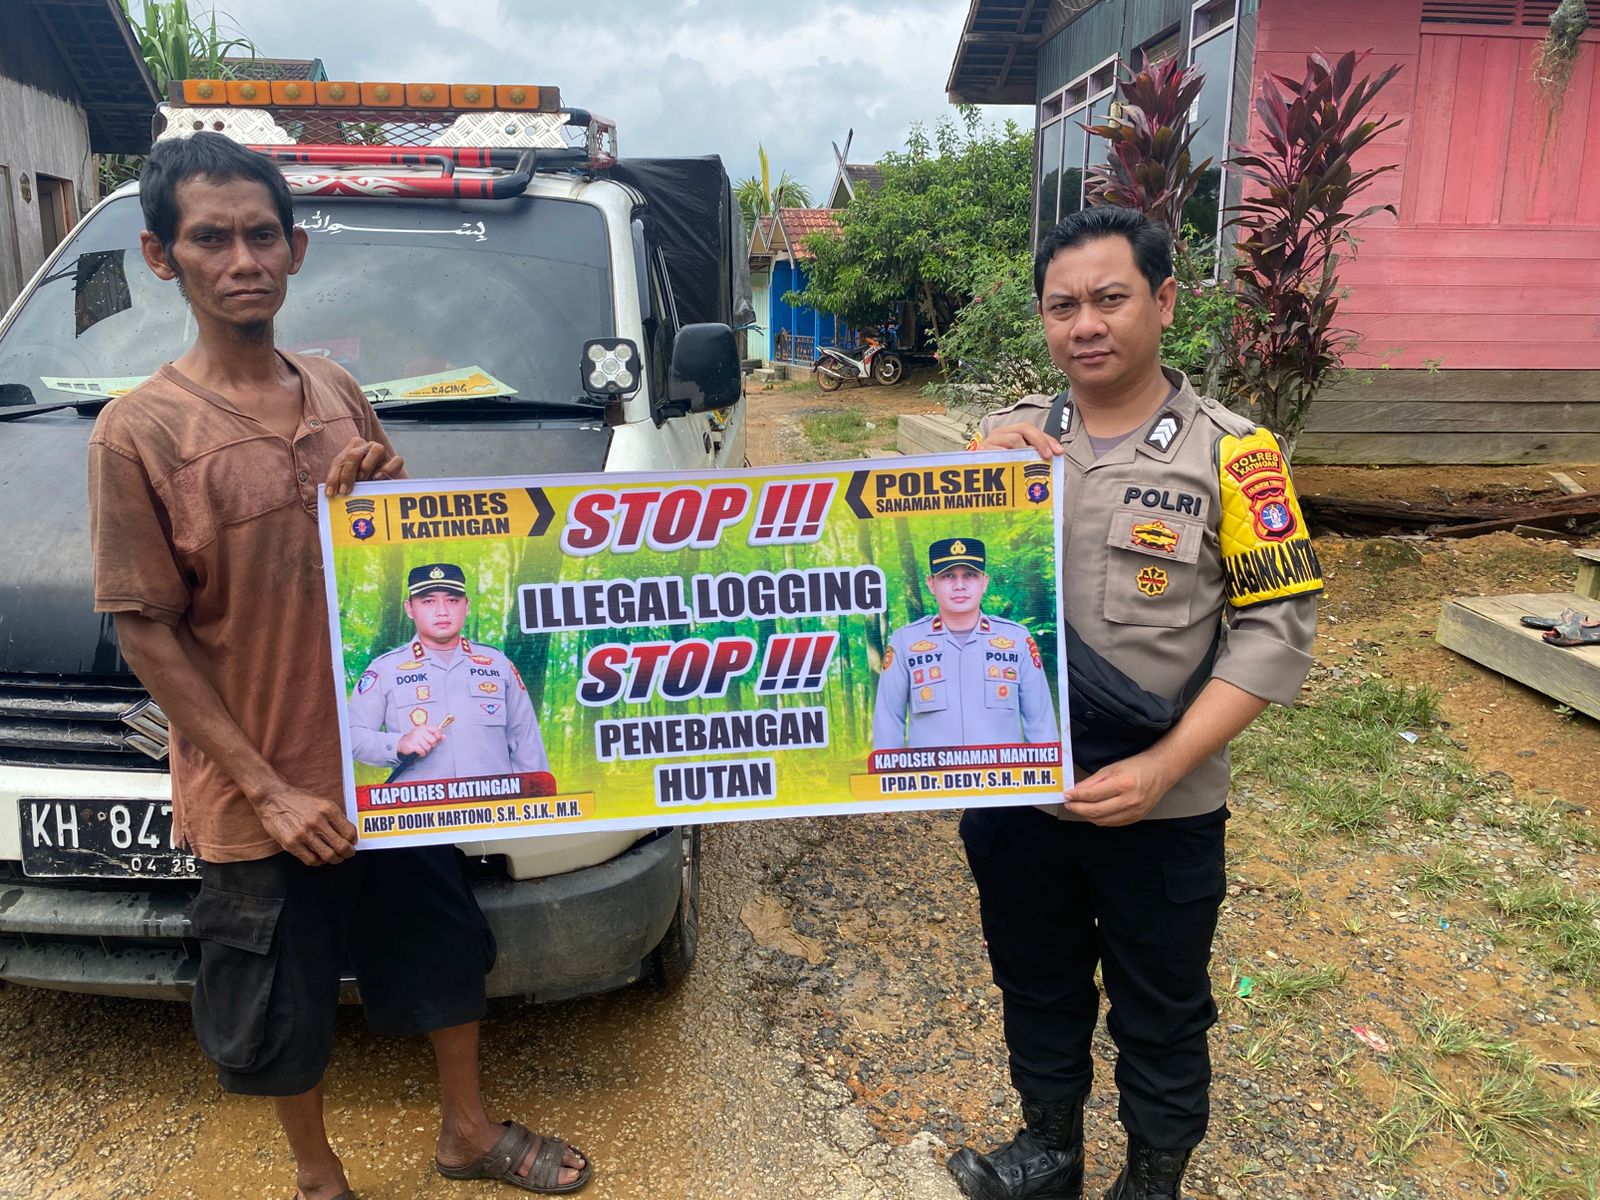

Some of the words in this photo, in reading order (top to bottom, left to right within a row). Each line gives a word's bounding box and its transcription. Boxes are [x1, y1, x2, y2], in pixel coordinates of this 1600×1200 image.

[431, 384, 468, 395] RACING
[1231, 452, 1279, 472] POLRES
[875, 467, 1006, 498] POLSEK
[399, 492, 509, 520] POLRES
[876, 495, 942, 514] SANAMAN
[943, 492, 1007, 511] MANTIKEI
[1123, 486, 1202, 517] POLRI
[566, 487, 749, 549] STOP
[754, 482, 835, 539] !!!
[401, 517, 510, 540] KATINGAN
[522, 579, 688, 630] ILLEGAL
[696, 568, 883, 620] LOGGING
[579, 640, 754, 702] STOP
[758, 635, 836, 691] !!!
[907, 653, 943, 668] DEDY
[985, 651, 1019, 664] POLRI
[396, 672, 428, 686] DODIK
[470, 668, 501, 678] POLRI
[599, 710, 825, 758] PENEBANGAN
[874, 752, 936, 770] KAPOLSEK
[937, 749, 998, 768] SANAMAN
[999, 747, 1059, 765] MANTIKEI
[369, 781, 446, 806] KAPOLRES
[447, 778, 521, 799] KATINGAN
[658, 762, 773, 803] HUTAN
[881, 776, 918, 793] IPDA
[920, 775, 941, 791] Dr.
[944, 772, 984, 790] DEDY,
[987, 771, 1020, 788] S.H.,
[1023, 770, 1056, 786] M.H.
[31, 803, 79, 849] KH
[363, 812, 396, 833] AKBP
[397, 811, 435, 831] DODIK
[437, 807, 496, 828] HARTONO,
[497, 805, 522, 823] S.H.,
[523, 803, 555, 821] S.I.K.,
[556, 801, 582, 817] M.H.
[131, 857, 157, 872] 04
[171, 858, 196, 873] 25
